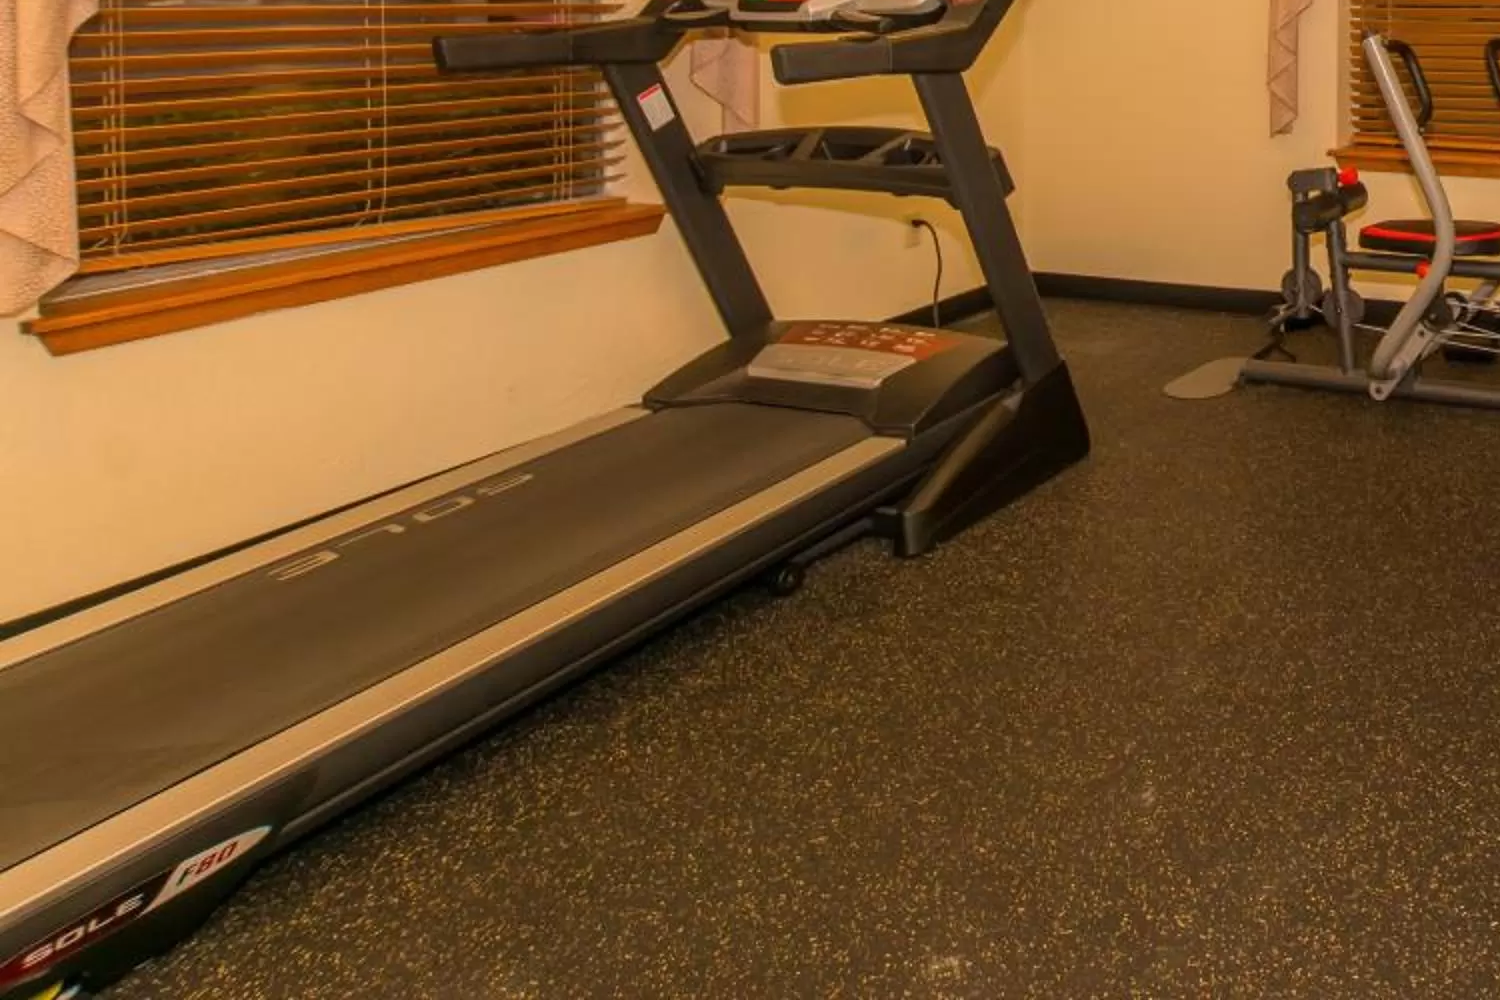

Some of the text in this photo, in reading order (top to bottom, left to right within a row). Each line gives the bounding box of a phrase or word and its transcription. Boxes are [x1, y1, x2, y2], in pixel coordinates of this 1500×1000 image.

[267, 473, 533, 581] SOLE
[22, 841, 238, 969] SOLE F80
